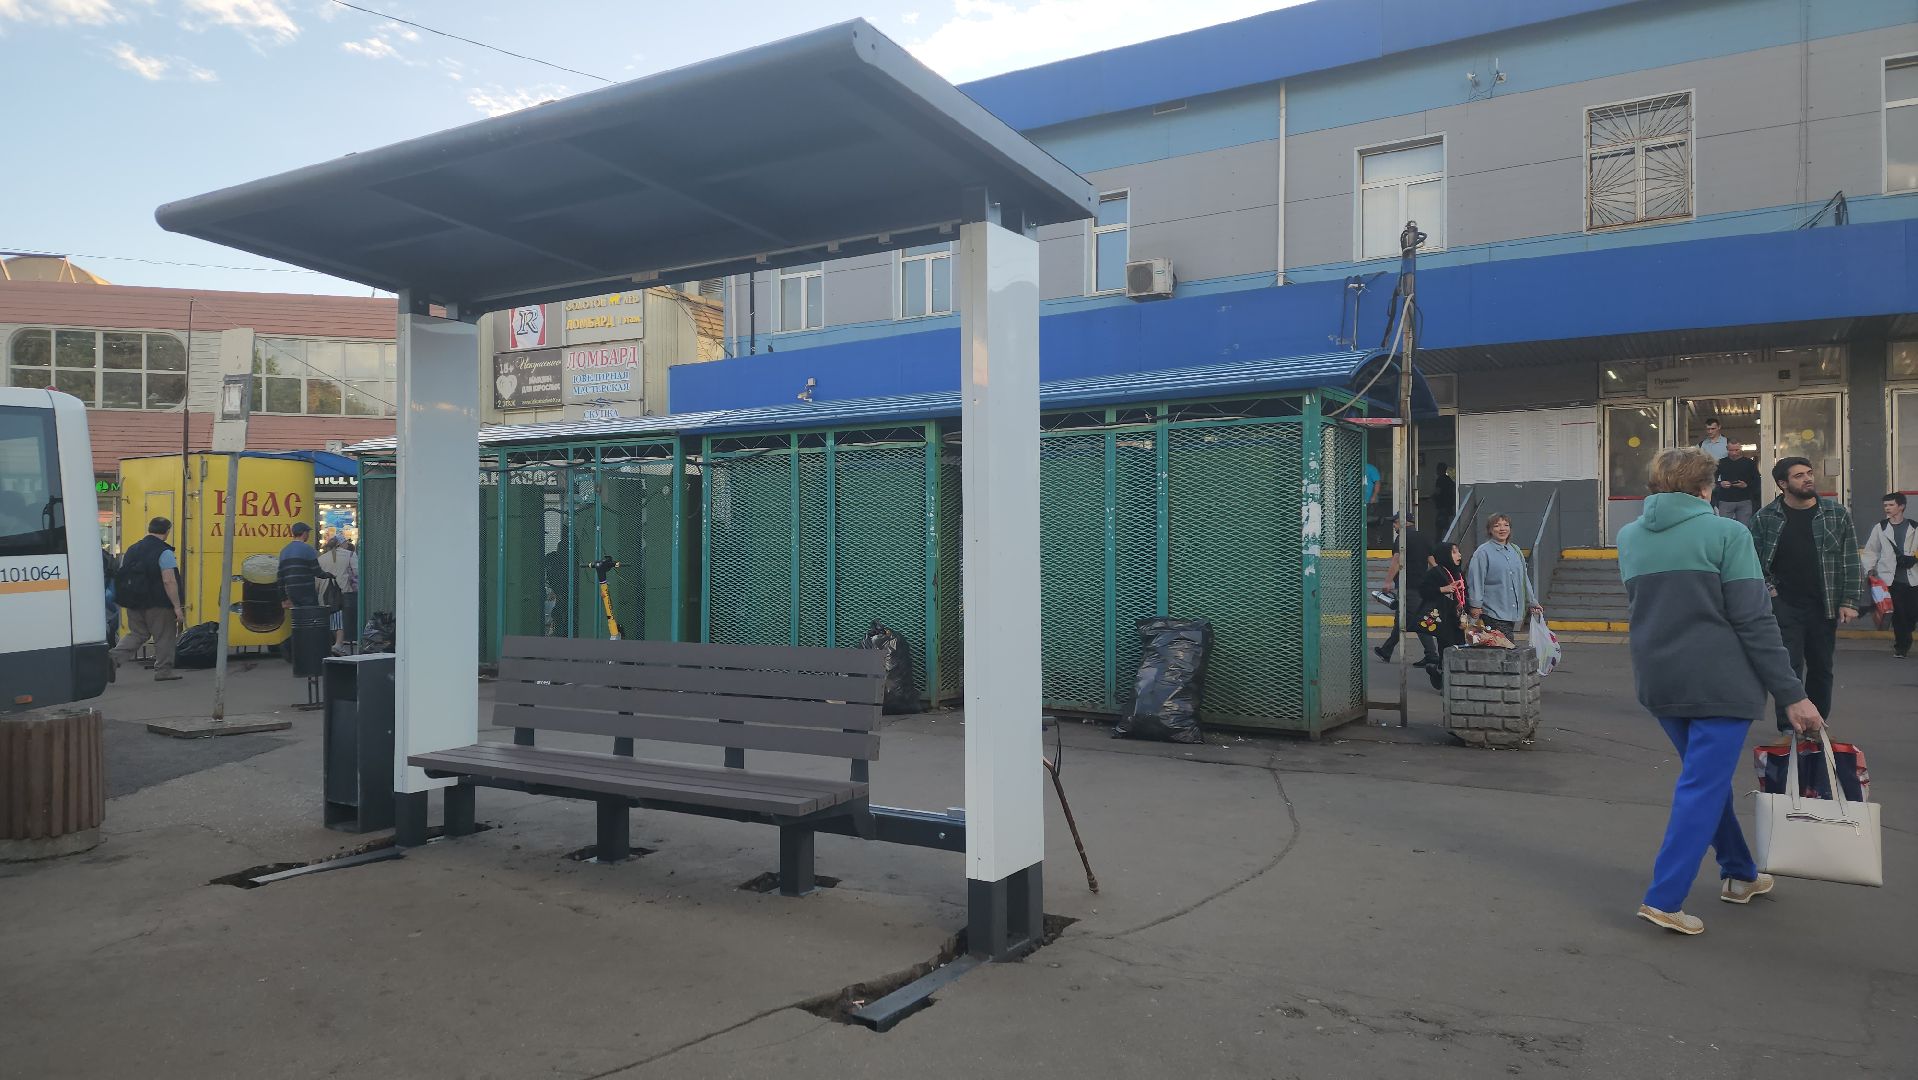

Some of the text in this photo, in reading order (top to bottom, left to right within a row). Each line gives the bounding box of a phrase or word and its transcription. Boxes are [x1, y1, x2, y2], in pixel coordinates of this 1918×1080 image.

[516, 309, 539, 335] R
[566, 313, 615, 330] ЛОМБАРД
[566, 345, 639, 370] ЛОМБАРД
[573, 370, 630, 384] ЮВЕЛИРНАЯ
[573, 382, 630, 395] МАСТЕРСКАЯ
[583, 408, 619, 419] СКУПКА
[214, 489, 302, 518] КВАС
[0, 565, 60, 583] 101064
